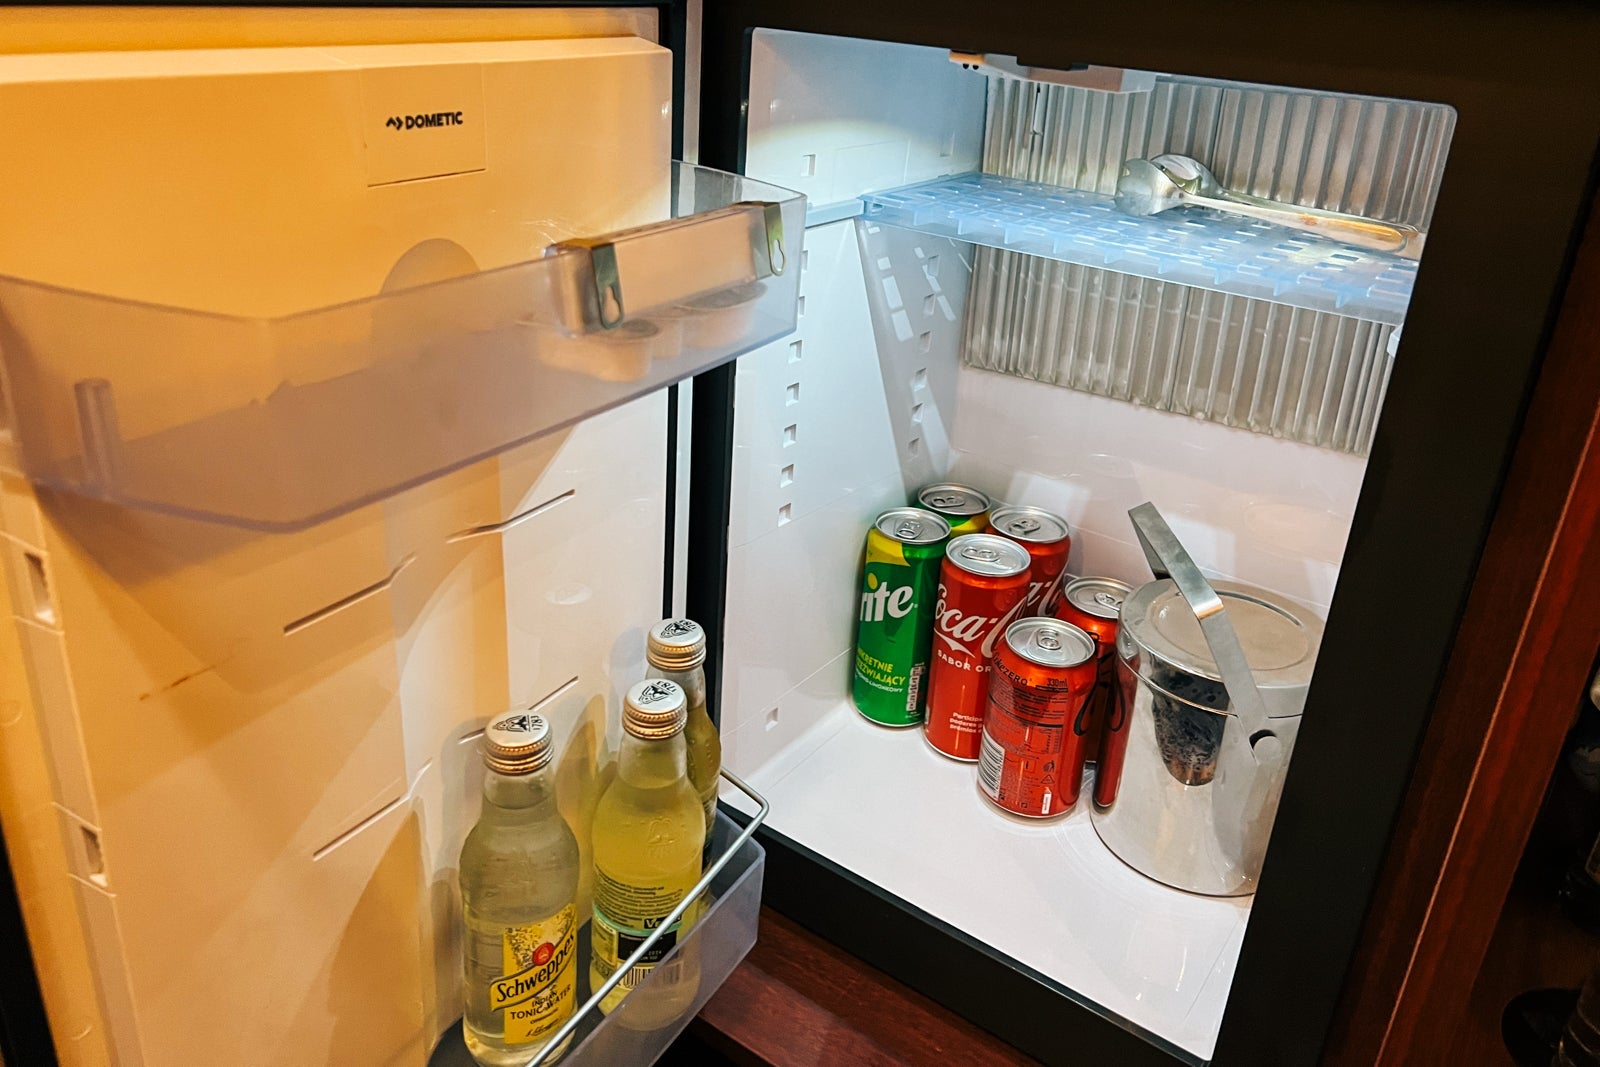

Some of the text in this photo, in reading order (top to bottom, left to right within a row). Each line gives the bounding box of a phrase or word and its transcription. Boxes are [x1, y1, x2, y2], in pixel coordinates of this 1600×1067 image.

[405, 111, 463, 130] DOMETIC
[937, 649, 971, 671] SABOR
[530, 715, 543, 730] 1783
[510, 1005, 546, 1020] TONIC
